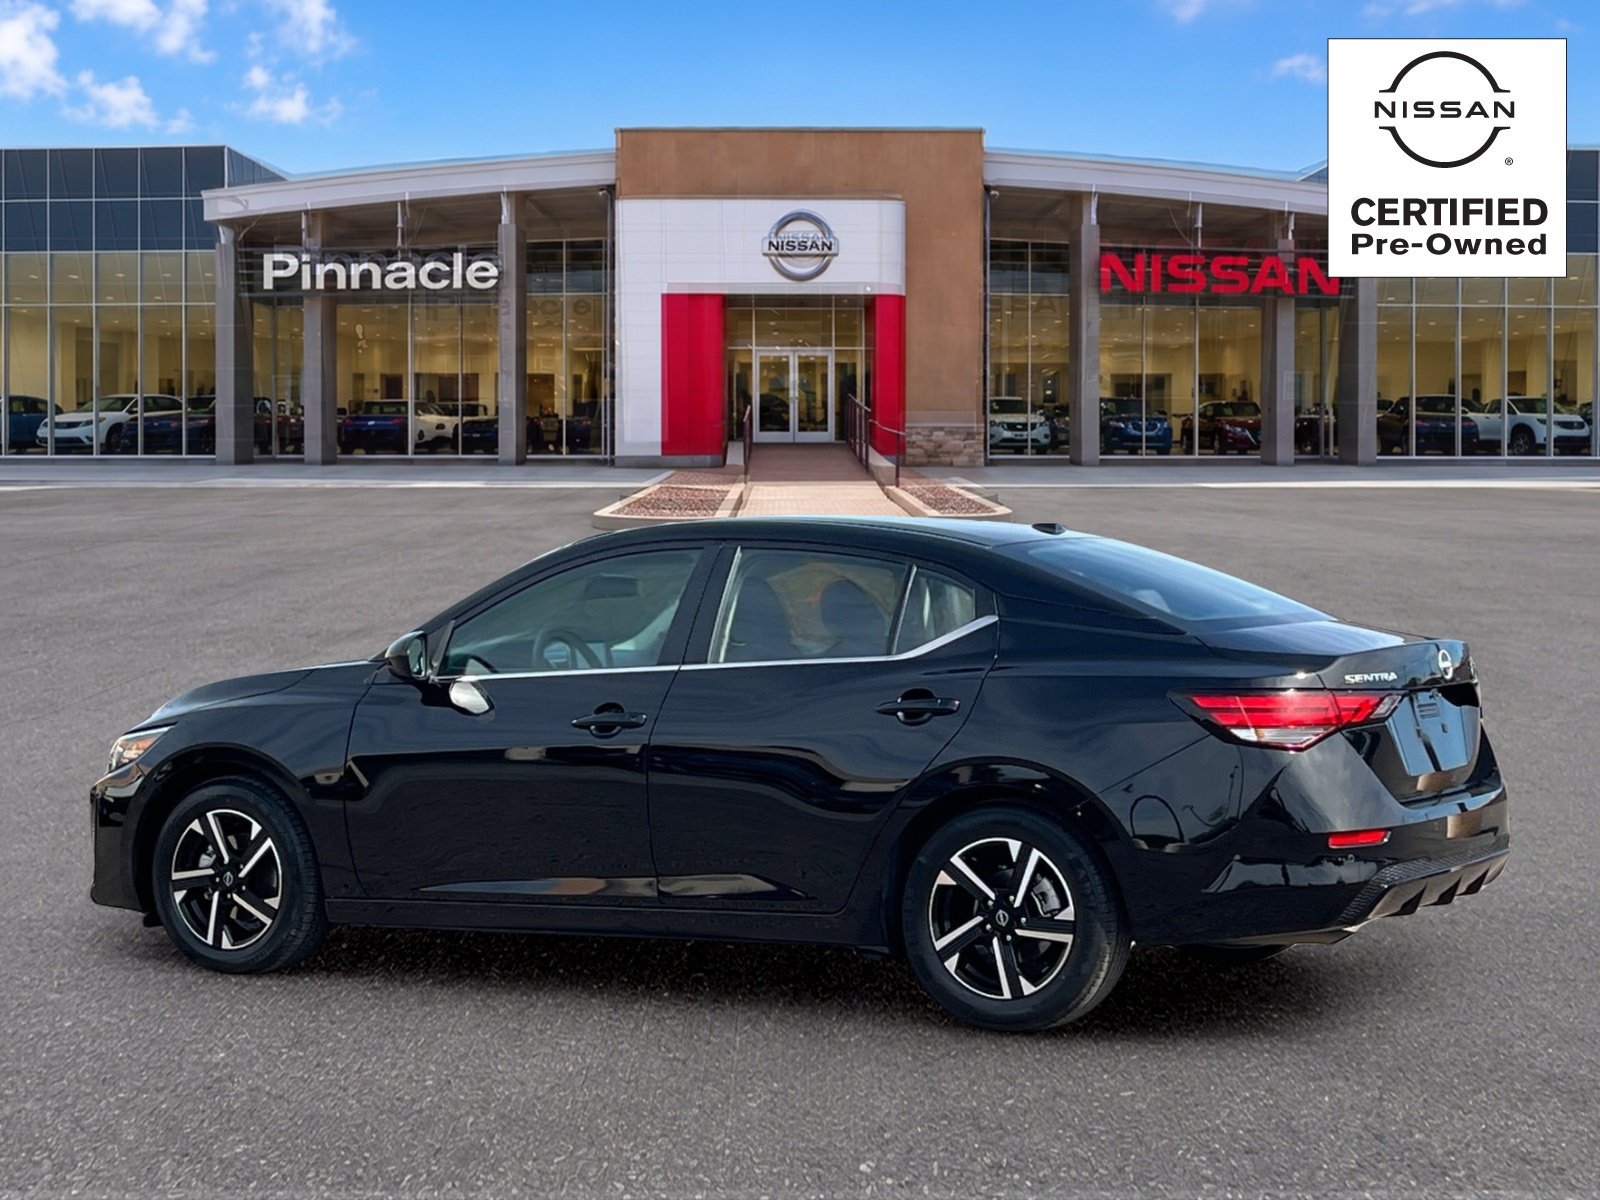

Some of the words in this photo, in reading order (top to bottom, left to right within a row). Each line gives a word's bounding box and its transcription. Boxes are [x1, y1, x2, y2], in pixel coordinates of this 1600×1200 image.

[768, 240, 833, 252] NISSAN
[263, 252, 500, 290] Pinnacle
[1099, 253, 1340, 295] NISSAN
[1344, 672, 1398, 684] SENTRA
